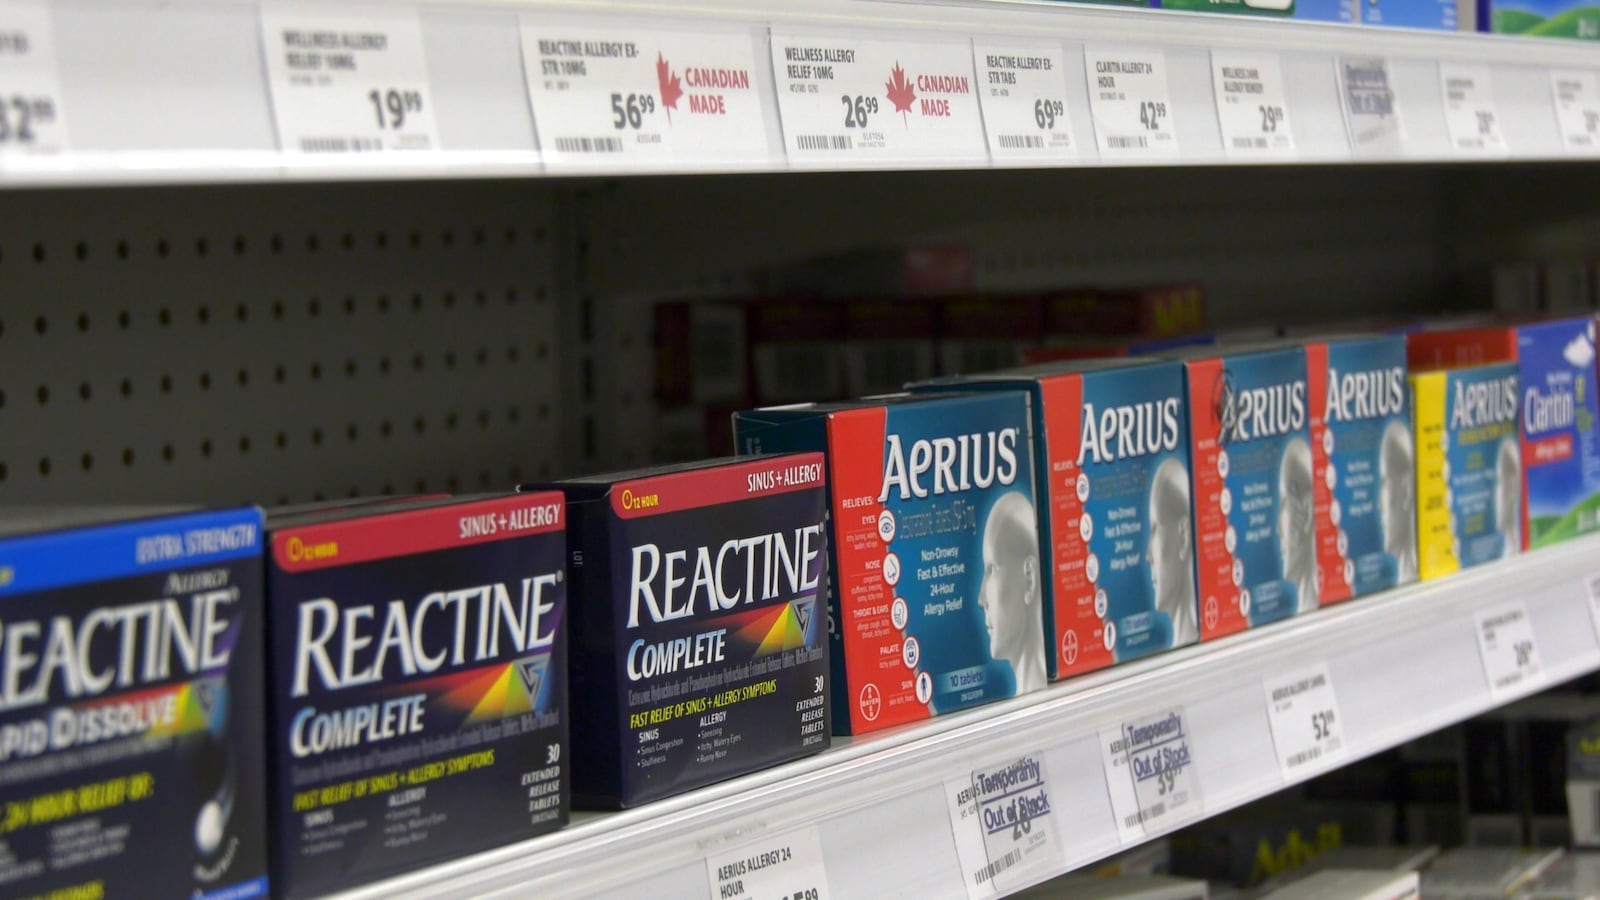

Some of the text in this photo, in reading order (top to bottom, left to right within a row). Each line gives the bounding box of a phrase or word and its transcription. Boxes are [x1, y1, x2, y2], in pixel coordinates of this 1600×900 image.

[342, 33, 387, 51] ALLERGY
[538, 40, 639, 58] REACTINE ALLERGY EX-
[785, 48, 855, 63] WELLNESS ALLERGY
[987, 55, 1017, 69] REACTINE
[1017, 58, 1043, 70] ALLERGY
[541, 60, 586, 76] STR 10MG
[787, 65, 834, 80] RELIEF 10MG
[1096, 61, 1121, 74] CLARITIN
[1121, 62, 1145, 74] ALLERGY
[685, 67, 749, 90] CANADIAN
[915, 75, 968, 94] CANADIAN
[988, 72, 1016, 84] STR TABS
[1098, 77, 1115, 89] HOUR
[690, 95, 726, 115] MADE
[918, 99, 949, 117] MADE
[1524, 386, 1574, 435] Claritin
[747, 471, 775, 492] SINUS
[784, 463, 821, 487] ALLERGY
[633, 494, 659, 509] 12 HOUR
[459, 513, 497, 539] SINUS
[509, 503, 561, 530] ALLERGY
[861, 515, 876, 526] EYES
[136, 524, 257, 564] EXTRA STRENGTH
[920, 547, 959, 562] Non-Drowsy
[864, 560, 881, 571] NOSE
[917, 568, 931, 581] Fast
[938, 563, 965, 577] Effective
[626, 524, 821, 629] REACTINE
[930, 583, 955, 597] 24-Hour
[853, 608, 872, 619] THROAT
[923, 597, 963, 617] Allergy Relief
[291, 573, 557, 698] REACTINE
[0, 590, 232, 712] EACTINE
[626, 628, 727, 681] COMPLETE
[879, 643, 900, 656] PALATE
[814, 675, 824, 694] 30
[950, 671, 984, 688] 10 tablets
[630, 712, 649, 729] FAST
[650, 707, 674, 725] RELIEF
[674, 704, 686, 718] OF
[686, 698, 707, 716] SINUS
[713, 689, 742, 708] ALLERGY
[742, 679, 777, 701] SYMPTOMS
[796, 695, 824, 712] EXTENDED
[50, 697, 178, 751] DISSOLVE
[699, 711, 727, 727] ALLERGY
[801, 708, 824, 723] RELEASE
[289, 693, 427, 758] COMPLETE
[800, 720, 824, 735] TABLETS
[1127, 712, 1182, 746] Temporarily
[639, 729, 660, 744] SINUS
[547, 743, 560, 765] 30
[1133, 754, 1153, 778] Out
[1162, 740, 1190, 771] Stock
[293, 789, 319, 812] FAST
[406, 763, 445, 784] ALLERGY
[447, 749, 495, 776] SYMPTOMS
[521, 765, 560, 786] EXTENDED
[977, 758, 1040, 795] Temporarily
[529, 780, 560, 799] RELEASE
[529, 794, 560, 813] TABLETS
[984, 788, 1050, 830] Out of Stock
[718, 846, 792, 882] AERIUS ALLERGY 24
[720, 880, 745, 899] HOUR
